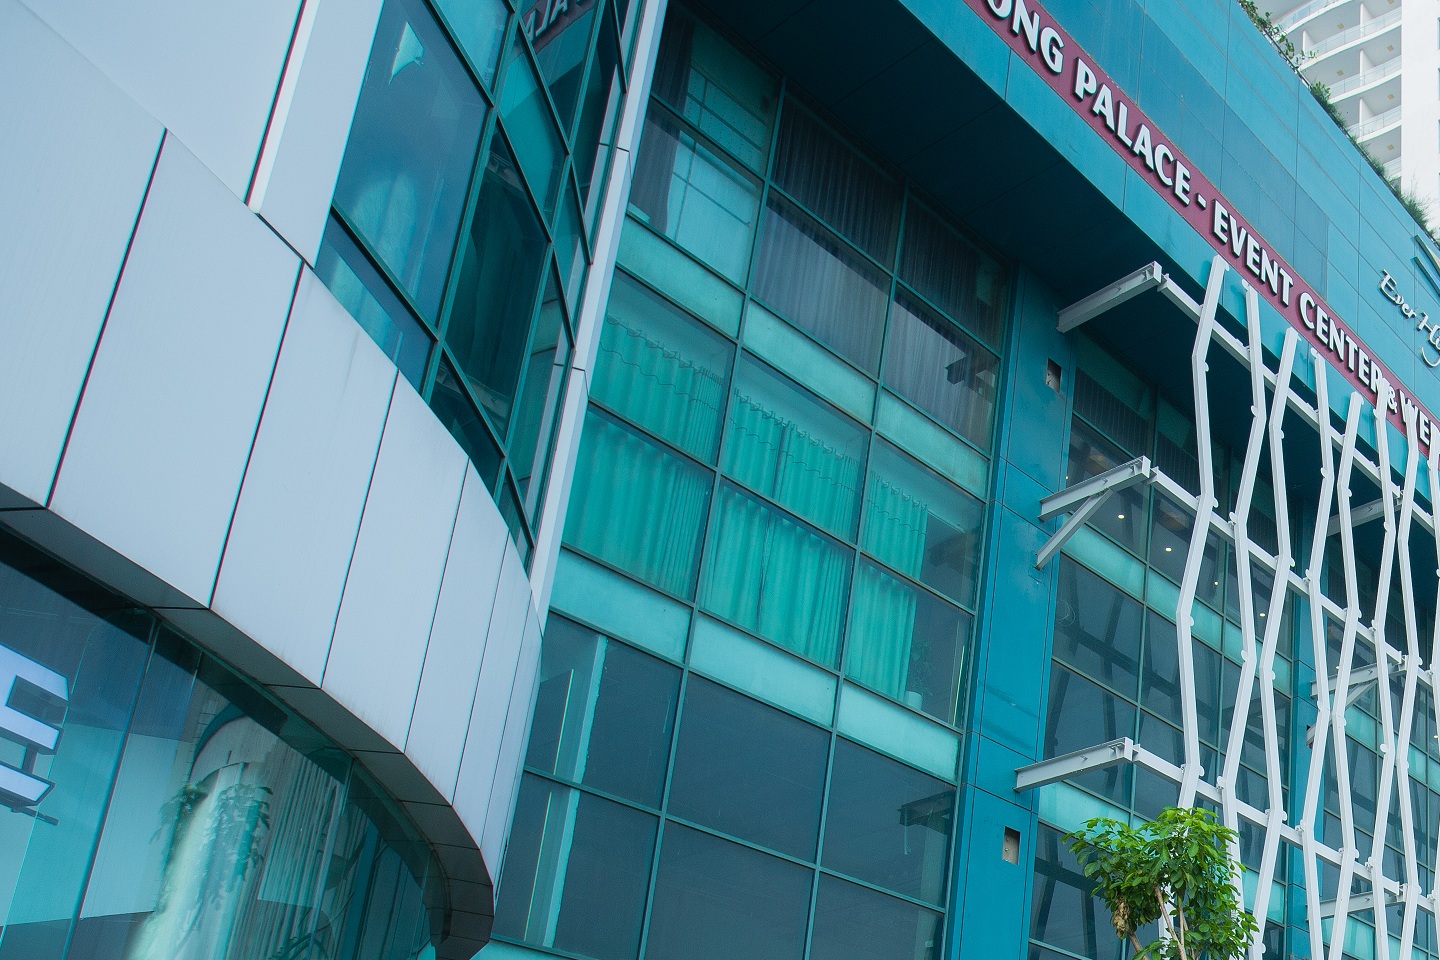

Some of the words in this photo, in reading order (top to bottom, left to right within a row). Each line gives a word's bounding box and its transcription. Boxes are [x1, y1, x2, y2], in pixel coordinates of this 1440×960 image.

[1073, 56, 1192, 207] PALACE
[1213, 199, 1295, 307] EVENT
[1298, 292, 1386, 396] CENTER
[1379, 268, 1417, 319] Ever
